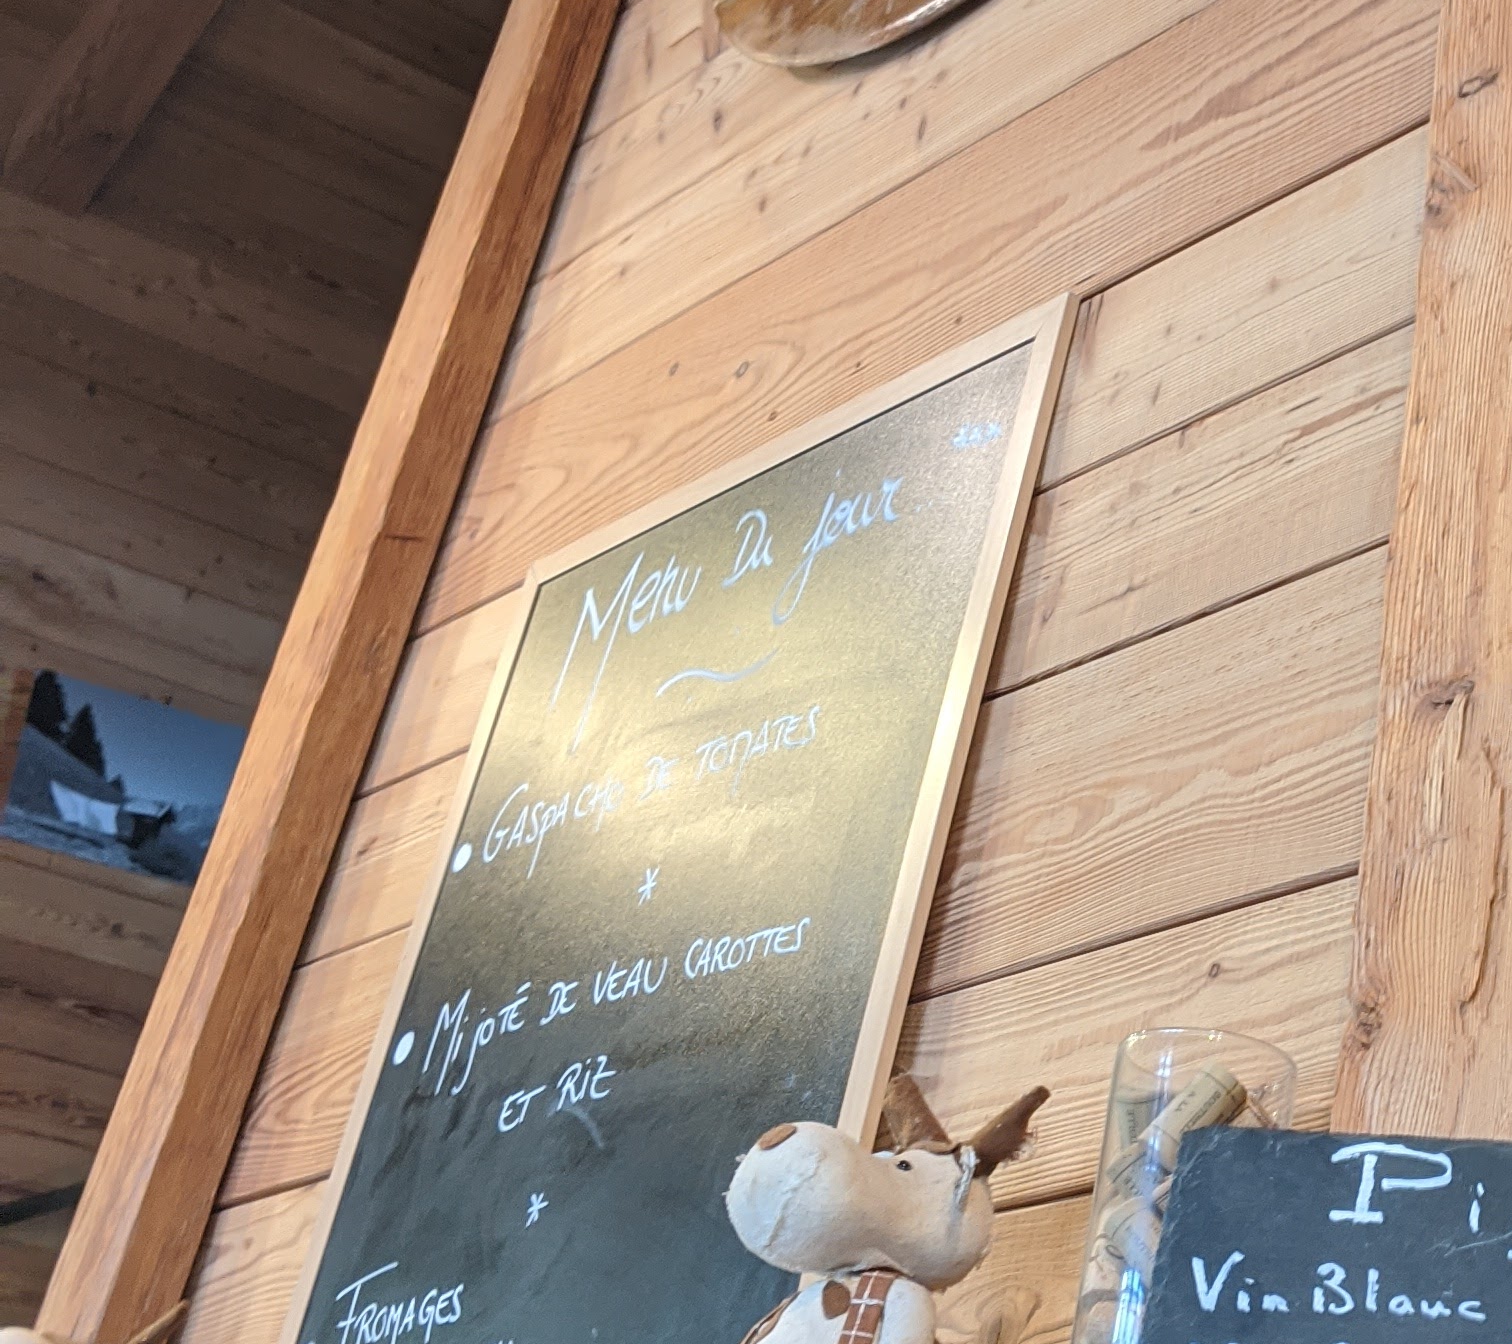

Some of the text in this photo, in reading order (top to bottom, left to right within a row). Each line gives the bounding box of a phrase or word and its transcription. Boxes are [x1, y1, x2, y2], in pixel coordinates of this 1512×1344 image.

[552, 551, 701, 752] Menu
[721, 509, 773, 588] Du
[539, 981, 579, 1027] DE
[592, 958, 669, 1006] VEAU
[684, 917, 812, 980] CAROTTES
[498, 1084, 547, 1133] ET
[1191, 1250, 1290, 1313] Vin
[1311, 1261, 1487, 1323] Blanc
